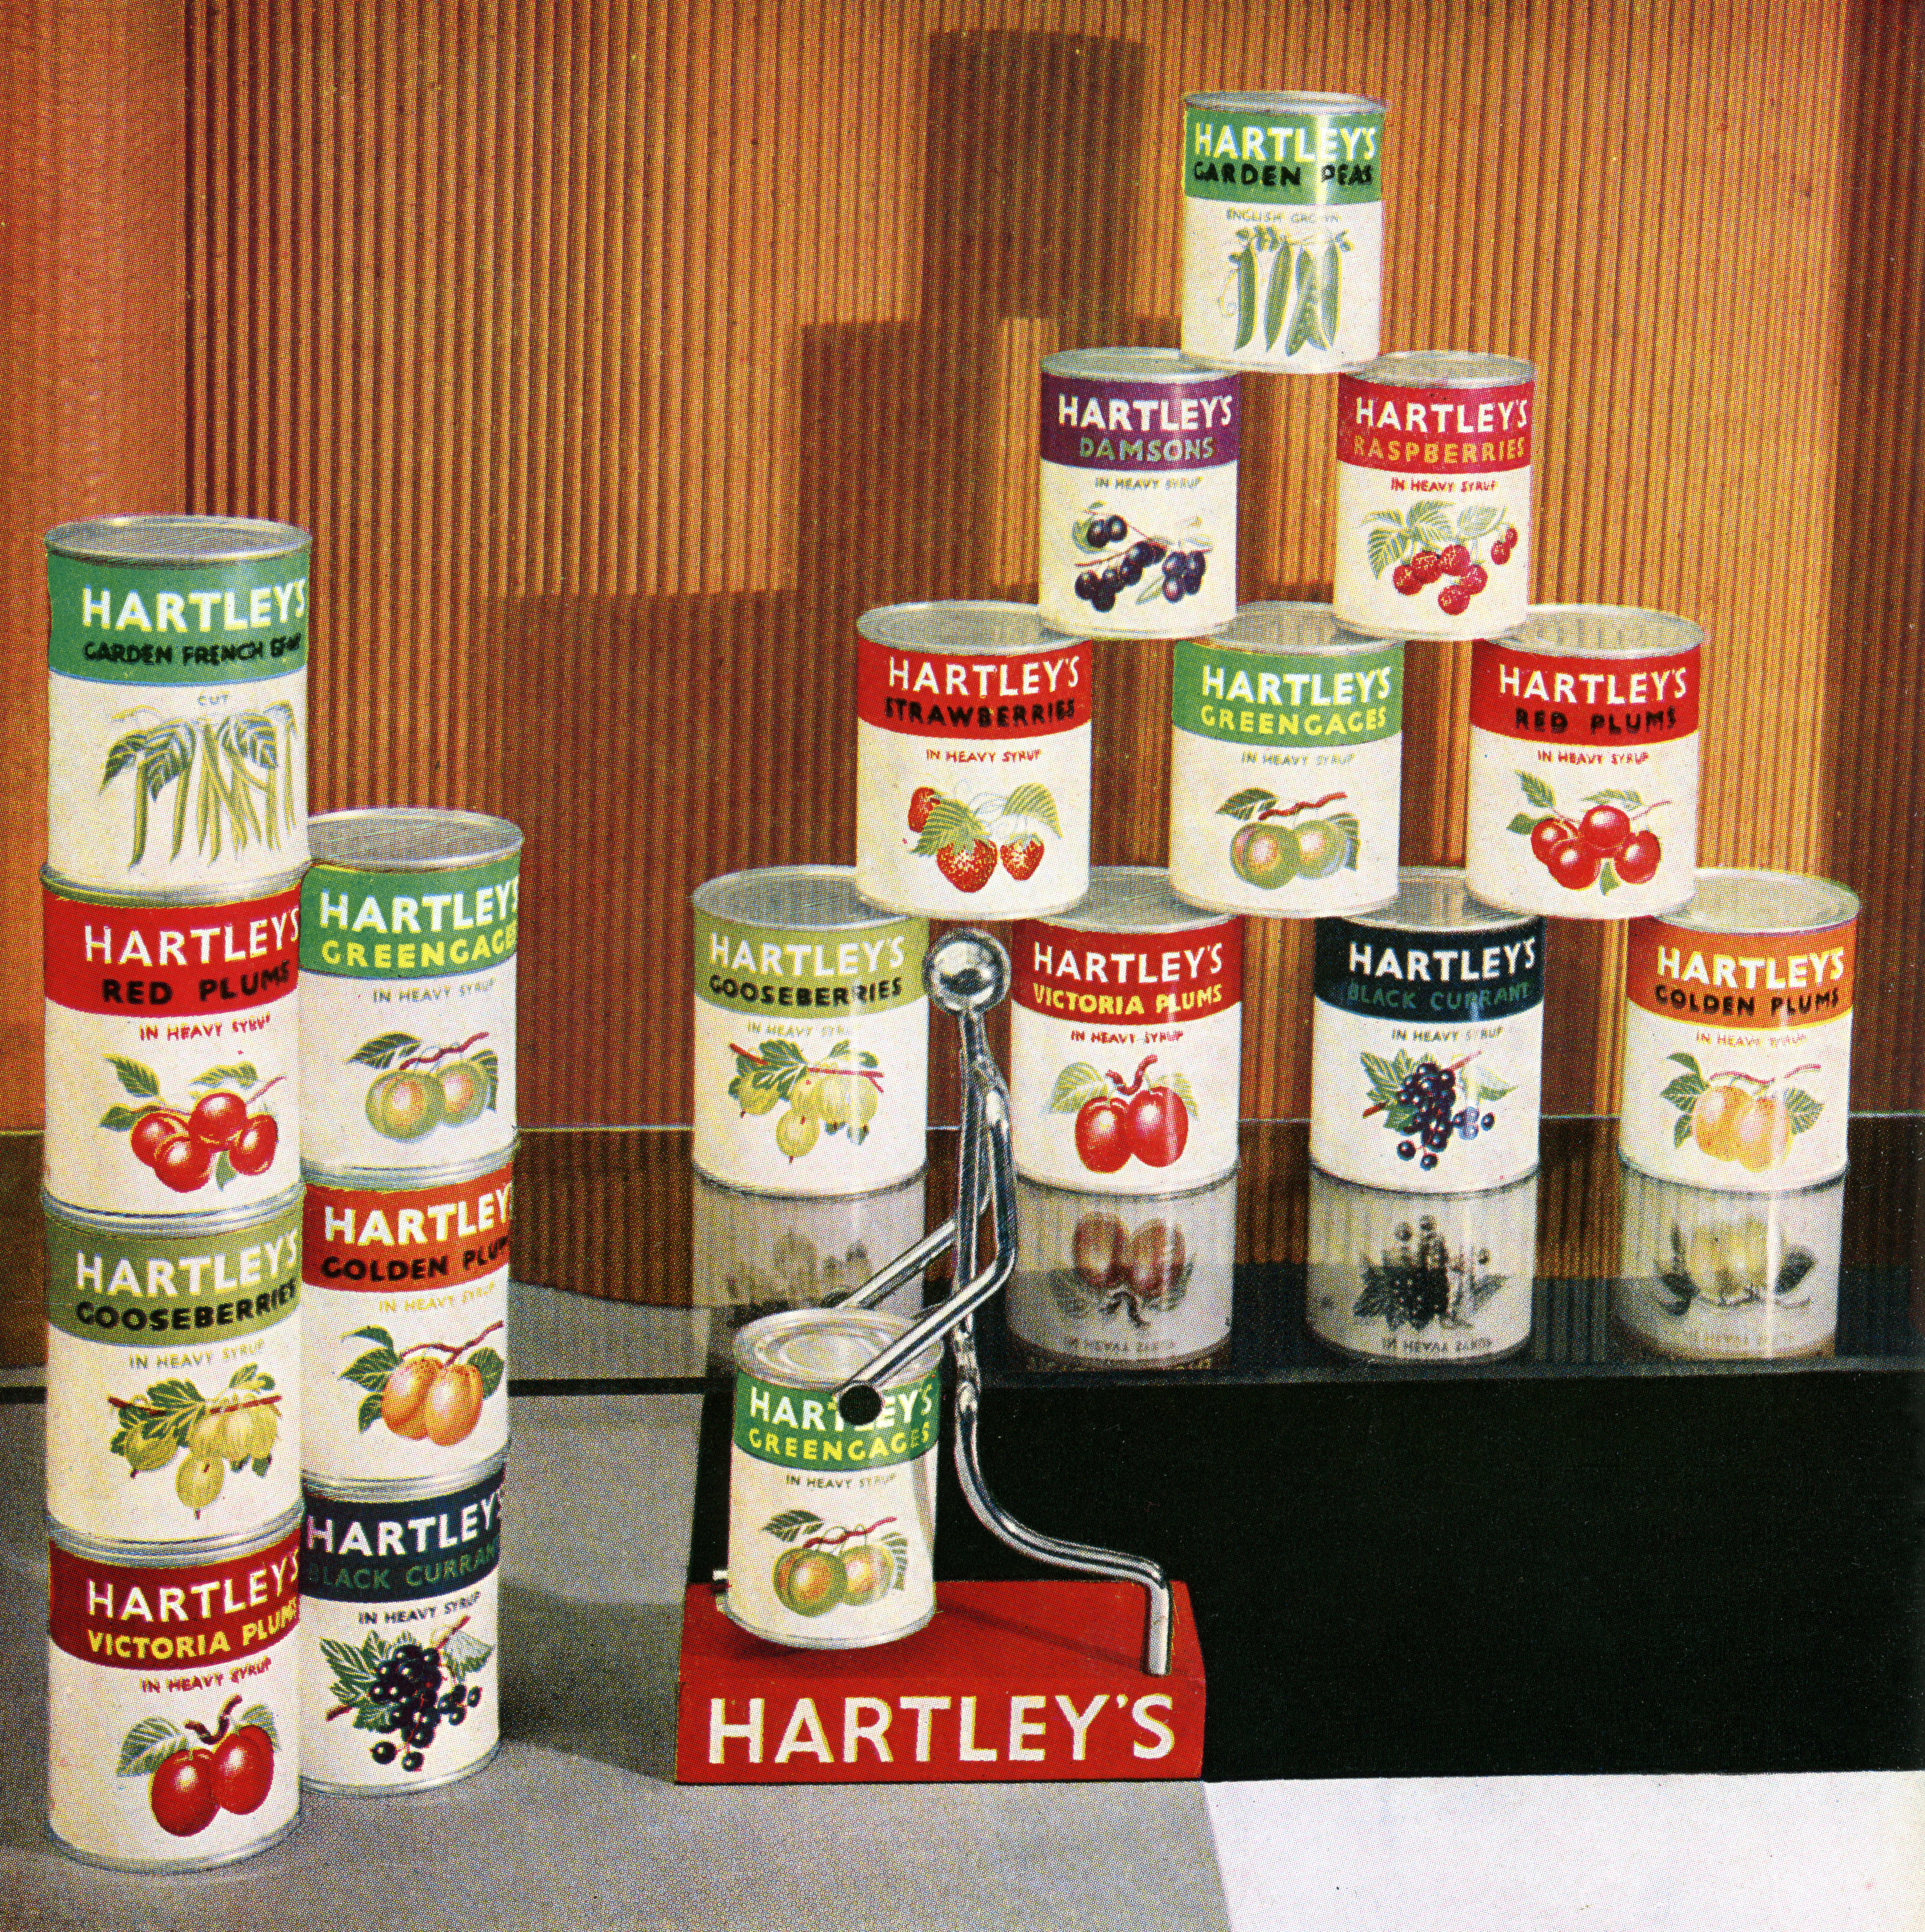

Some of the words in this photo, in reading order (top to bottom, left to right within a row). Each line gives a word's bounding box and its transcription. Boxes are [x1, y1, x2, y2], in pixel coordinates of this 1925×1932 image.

[1194, 162, 1301, 186] GARDEN
[1322, 164, 1373, 186] PEAS
[1226, 207, 1285, 223] ENGLISH
[1356, 397, 1527, 433] HARTLEY'S
[1080, 437, 1213, 461] DAMSONS
[1354, 435, 1524, 463] RASPBERRIES
[1095, 476, 1112, 488] IN
[1115, 477, 1160, 490] HEAVY
[1391, 477, 1407, 491] IN
[1410, 478, 1456, 493] HEAVY
[83, 642, 172, 665] GARDEN
[182, 641, 263, 665] FRENCH
[889, 656, 1079, 696] HARTLEY'S
[1499, 664, 1687, 705] HARTLEY'S
[885, 697, 1075, 728] STRAWBERRIES
[1201, 705, 1386, 735] GREENGAGES
[1516, 707, 1568, 733] RED
[1591, 706, 1676, 735] PLUMS
[927, 749, 941, 760] IN
[946, 751, 996, 764] HEAVY
[1002, 749, 1043, 763] SYRUP
[1242, 751, 1258, 763] IN
[1262, 753, 1309, 766] HEAVY
[1317, 753, 1356, 766] SYRUP
[1538, 750, 1552, 762] IN
[1558, 751, 1604, 764] HEAVY
[1612, 751, 1649, 764] SYRUP
[710, 932, 904, 977] HARTLEY'S
[1034, 942, 1222, 983] HARTLEY'S
[1349, 936, 1535, 982] HARTLEY'S
[103, 979, 173, 1005] RED
[199, 959, 290, 1001] PLUMS
[374, 988, 391, 1001] IN
[399, 985, 450, 1003] HEAVY
[709, 975, 902, 1006] GOOSEBERRIES
[1348, 982, 1416, 1009] BLACK
[1430, 982, 1529, 1010] CURRANT
[1034, 983, 1144, 1015] VICTORIA
[1156, 984, 1222, 1013] PLUMS
[1654, 985, 1754, 1015] GOLDEN
[1771, 988, 1839, 1015] PLUMS
[139, 1024, 158, 1040] IN
[167, 1022, 223, 1041] HEAVY
[232, 1011, 271, 1032] SYRUP
[747, 1020, 761, 1033] IN
[765, 1023, 813, 1037] HEAVY
[1071, 1030, 1085, 1042] IN
[1091, 1031, 1135, 1044] HEAVY
[1392, 1029, 1408, 1041] IN
[1412, 1030, 1459, 1042] HEAVY
[1465, 1026, 1503, 1041] SRUP
[1696, 1030, 1711, 1045] IN
[1717, 1034, 1762, 1048] HEAVY
[322, 1256, 447, 1281] GOLDEN
[379, 1300, 396, 1312] IN
[404, 1295, 453, 1312] HEAVY
[462, 1281, 494, 1303] SYRUP
[129, 1355, 147, 1368] IN
[157, 1350, 212, 1368] HEAVY
[223, 1338, 264, 1359] SYRUP
[749, 1422, 929, 1460] GREENGAGES
[786, 1473, 800, 1485] IN
[806, 1477, 852, 1489] HEAVY
[308, 1563, 391, 1590] BLACK
[358, 1612, 377, 1624] IN
[384, 1607, 436, 1624] HEAVY
[444, 1591, 480, 1614] SYRUP
[89, 1629, 230, 1659] VICTORIA
[139, 1677, 160, 1692] IN
[166, 1672, 223, 1692] HEAVY
[708, 1694, 1175, 1764] HARTLEY'S
